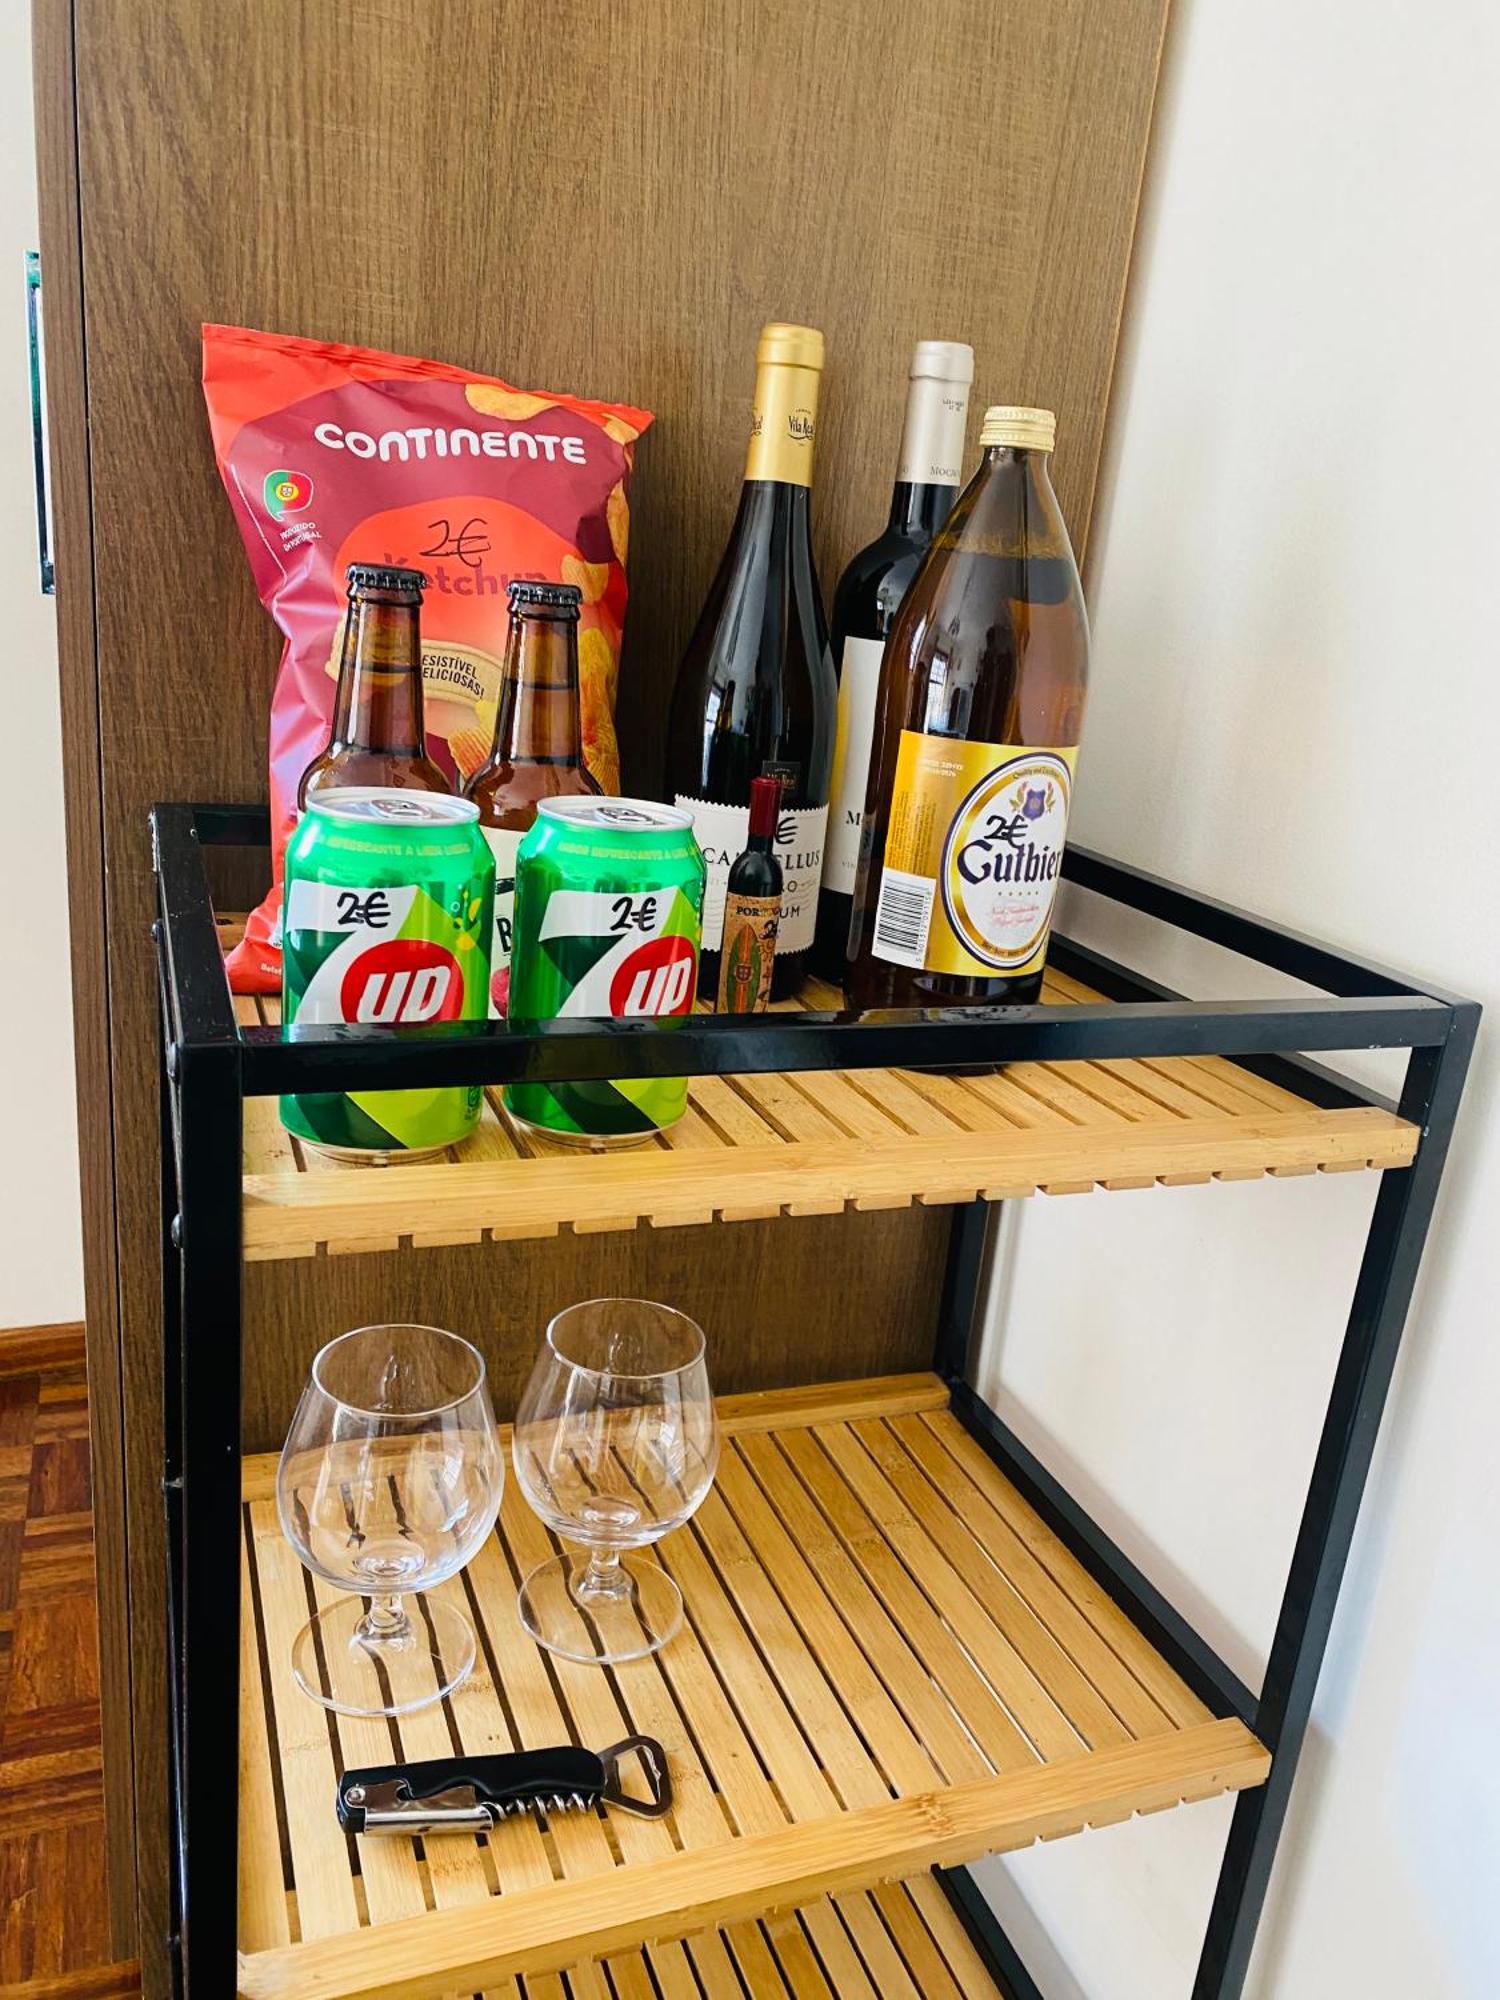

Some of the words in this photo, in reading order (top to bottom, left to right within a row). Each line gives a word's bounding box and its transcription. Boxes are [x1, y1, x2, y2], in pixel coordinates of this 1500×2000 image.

[314, 423, 587, 465] CONTINENTE
[419, 518, 492, 568] 2€
[421, 654, 477, 680] ESISTÍVEL
[421, 667, 485, 700] ELICIOSAS!
[984, 814, 1029, 849] 2€
[336, 891, 391, 929] 2€
[609, 896, 657, 932] 2€
